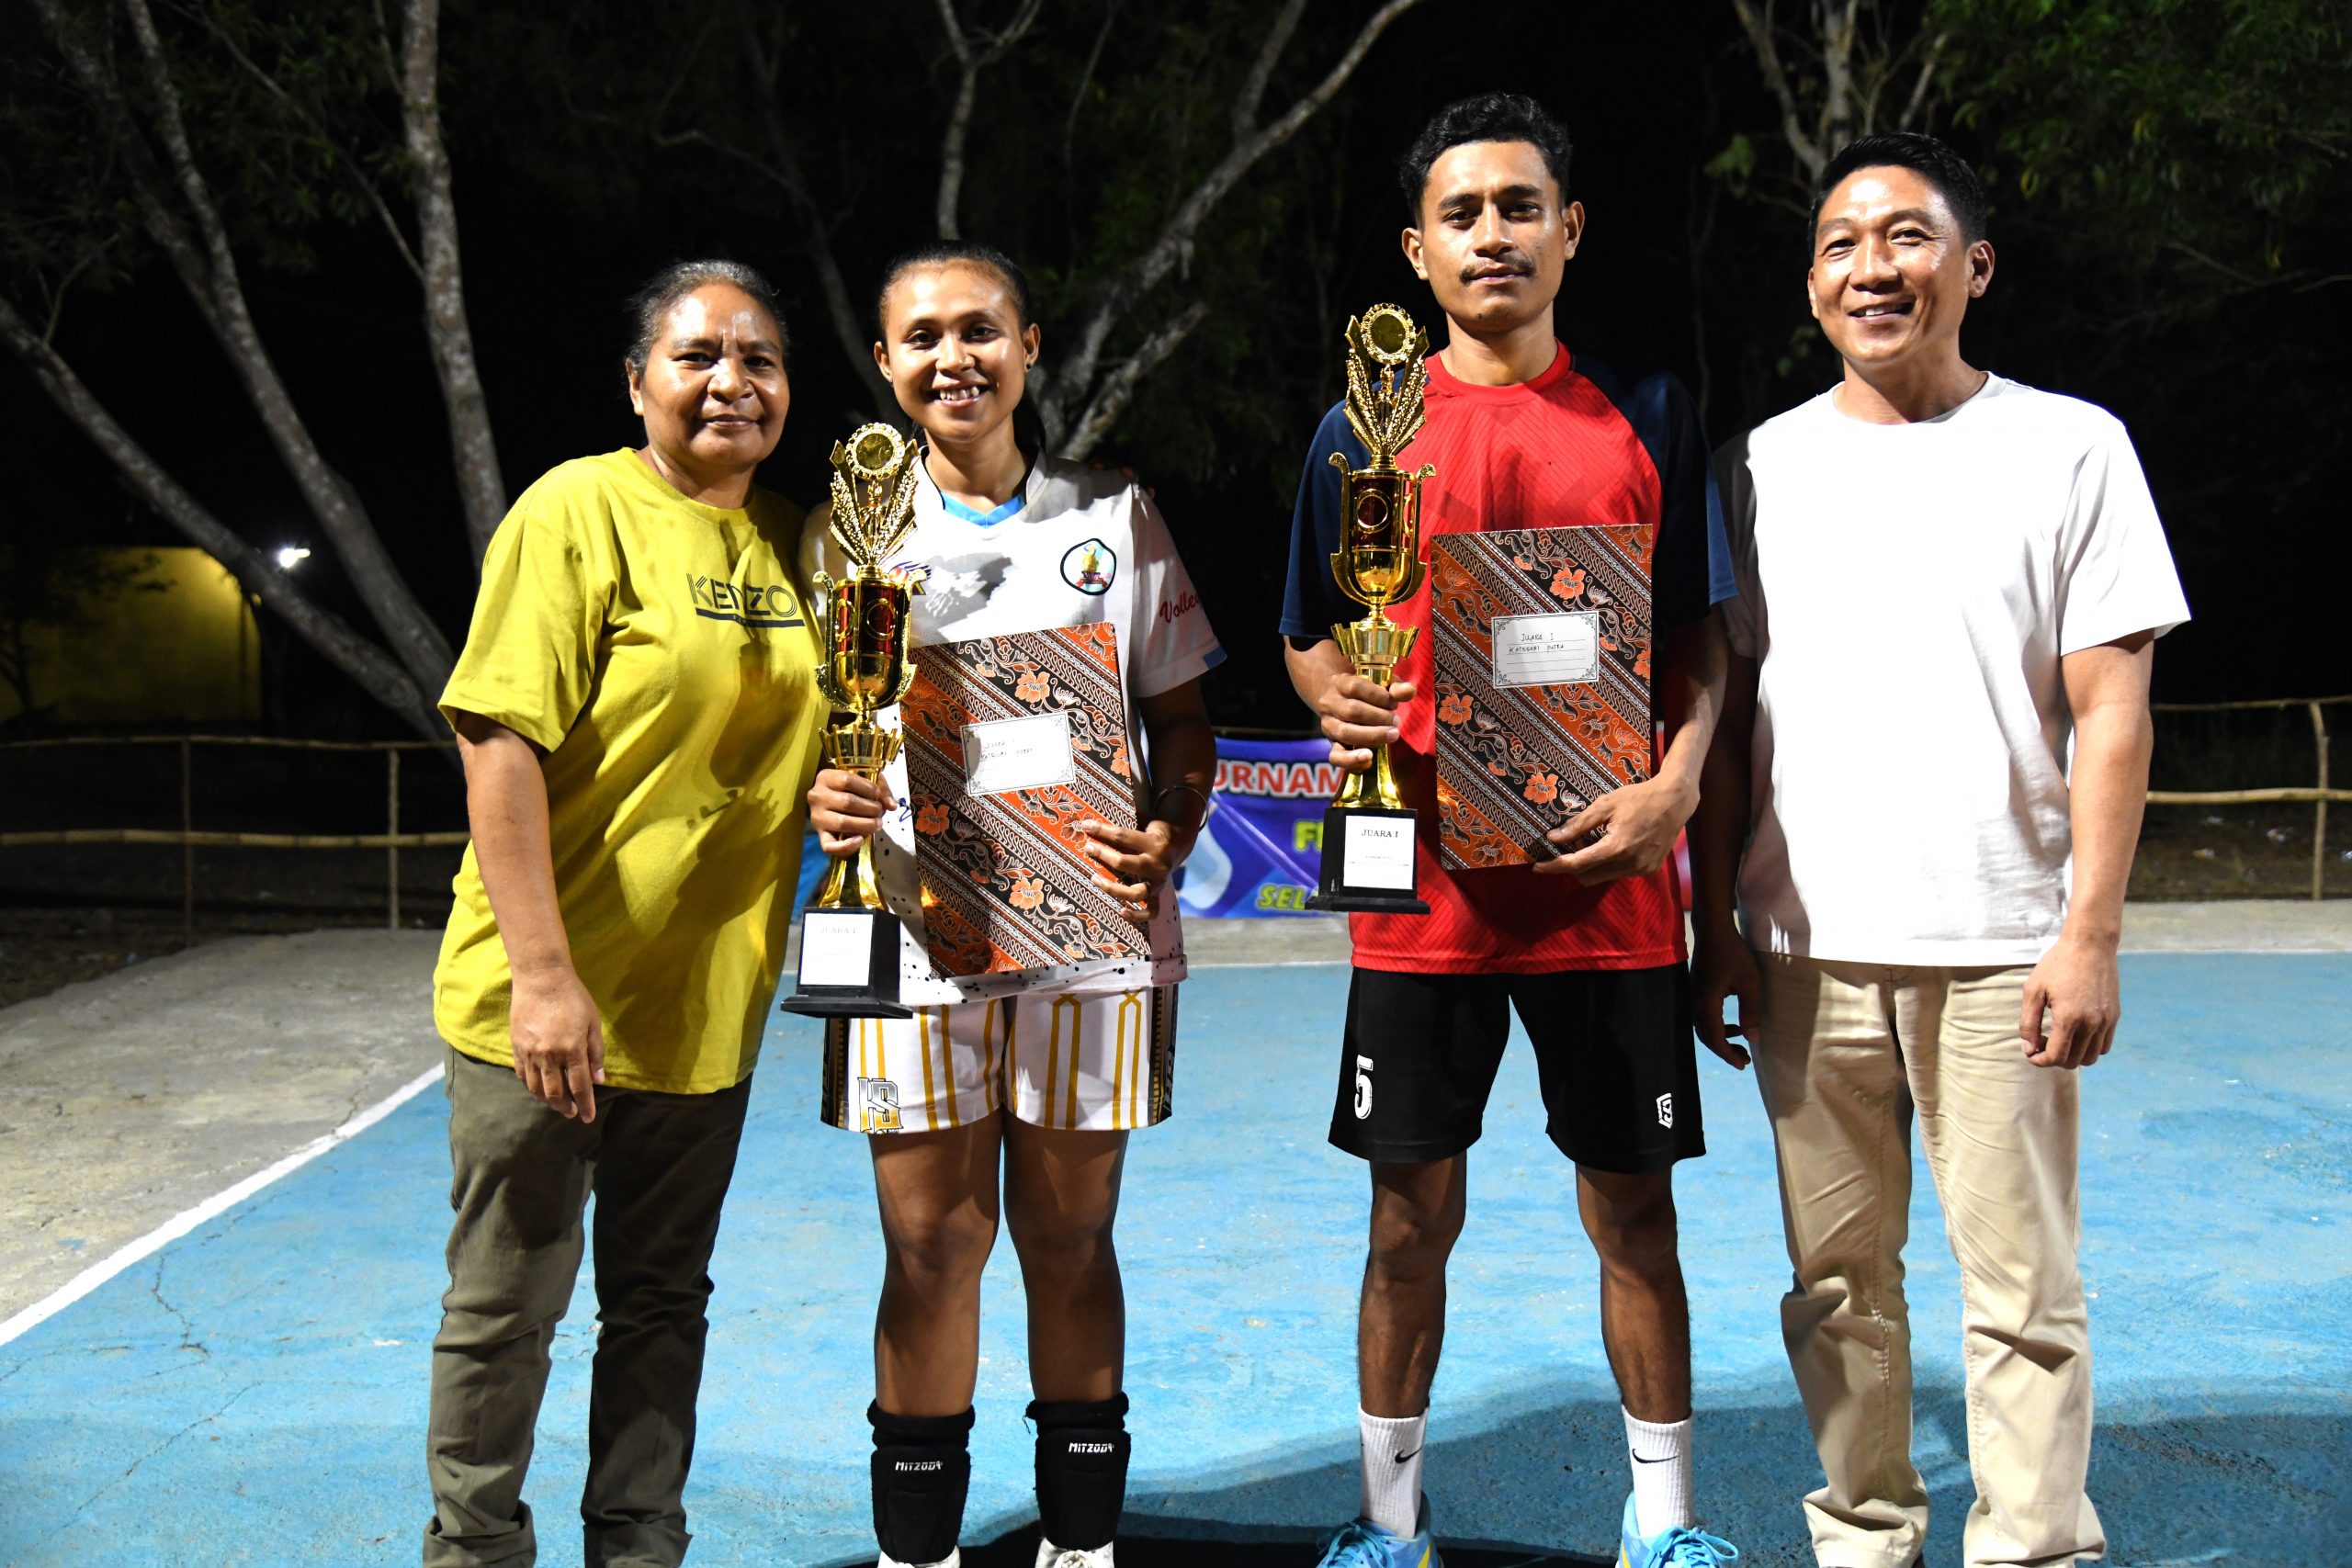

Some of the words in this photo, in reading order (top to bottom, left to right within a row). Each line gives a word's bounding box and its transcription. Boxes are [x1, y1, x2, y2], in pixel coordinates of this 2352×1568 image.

[686, 573, 797, 617] KENZO
[1521, 633, 1543, 642] JUARA
[1509, 645, 1540, 653] KATEGORI
[1361, 829, 1393, 838] JUARA
[1257, 885, 1316, 910] SEL
[1354, 1055, 1374, 1120] 5
